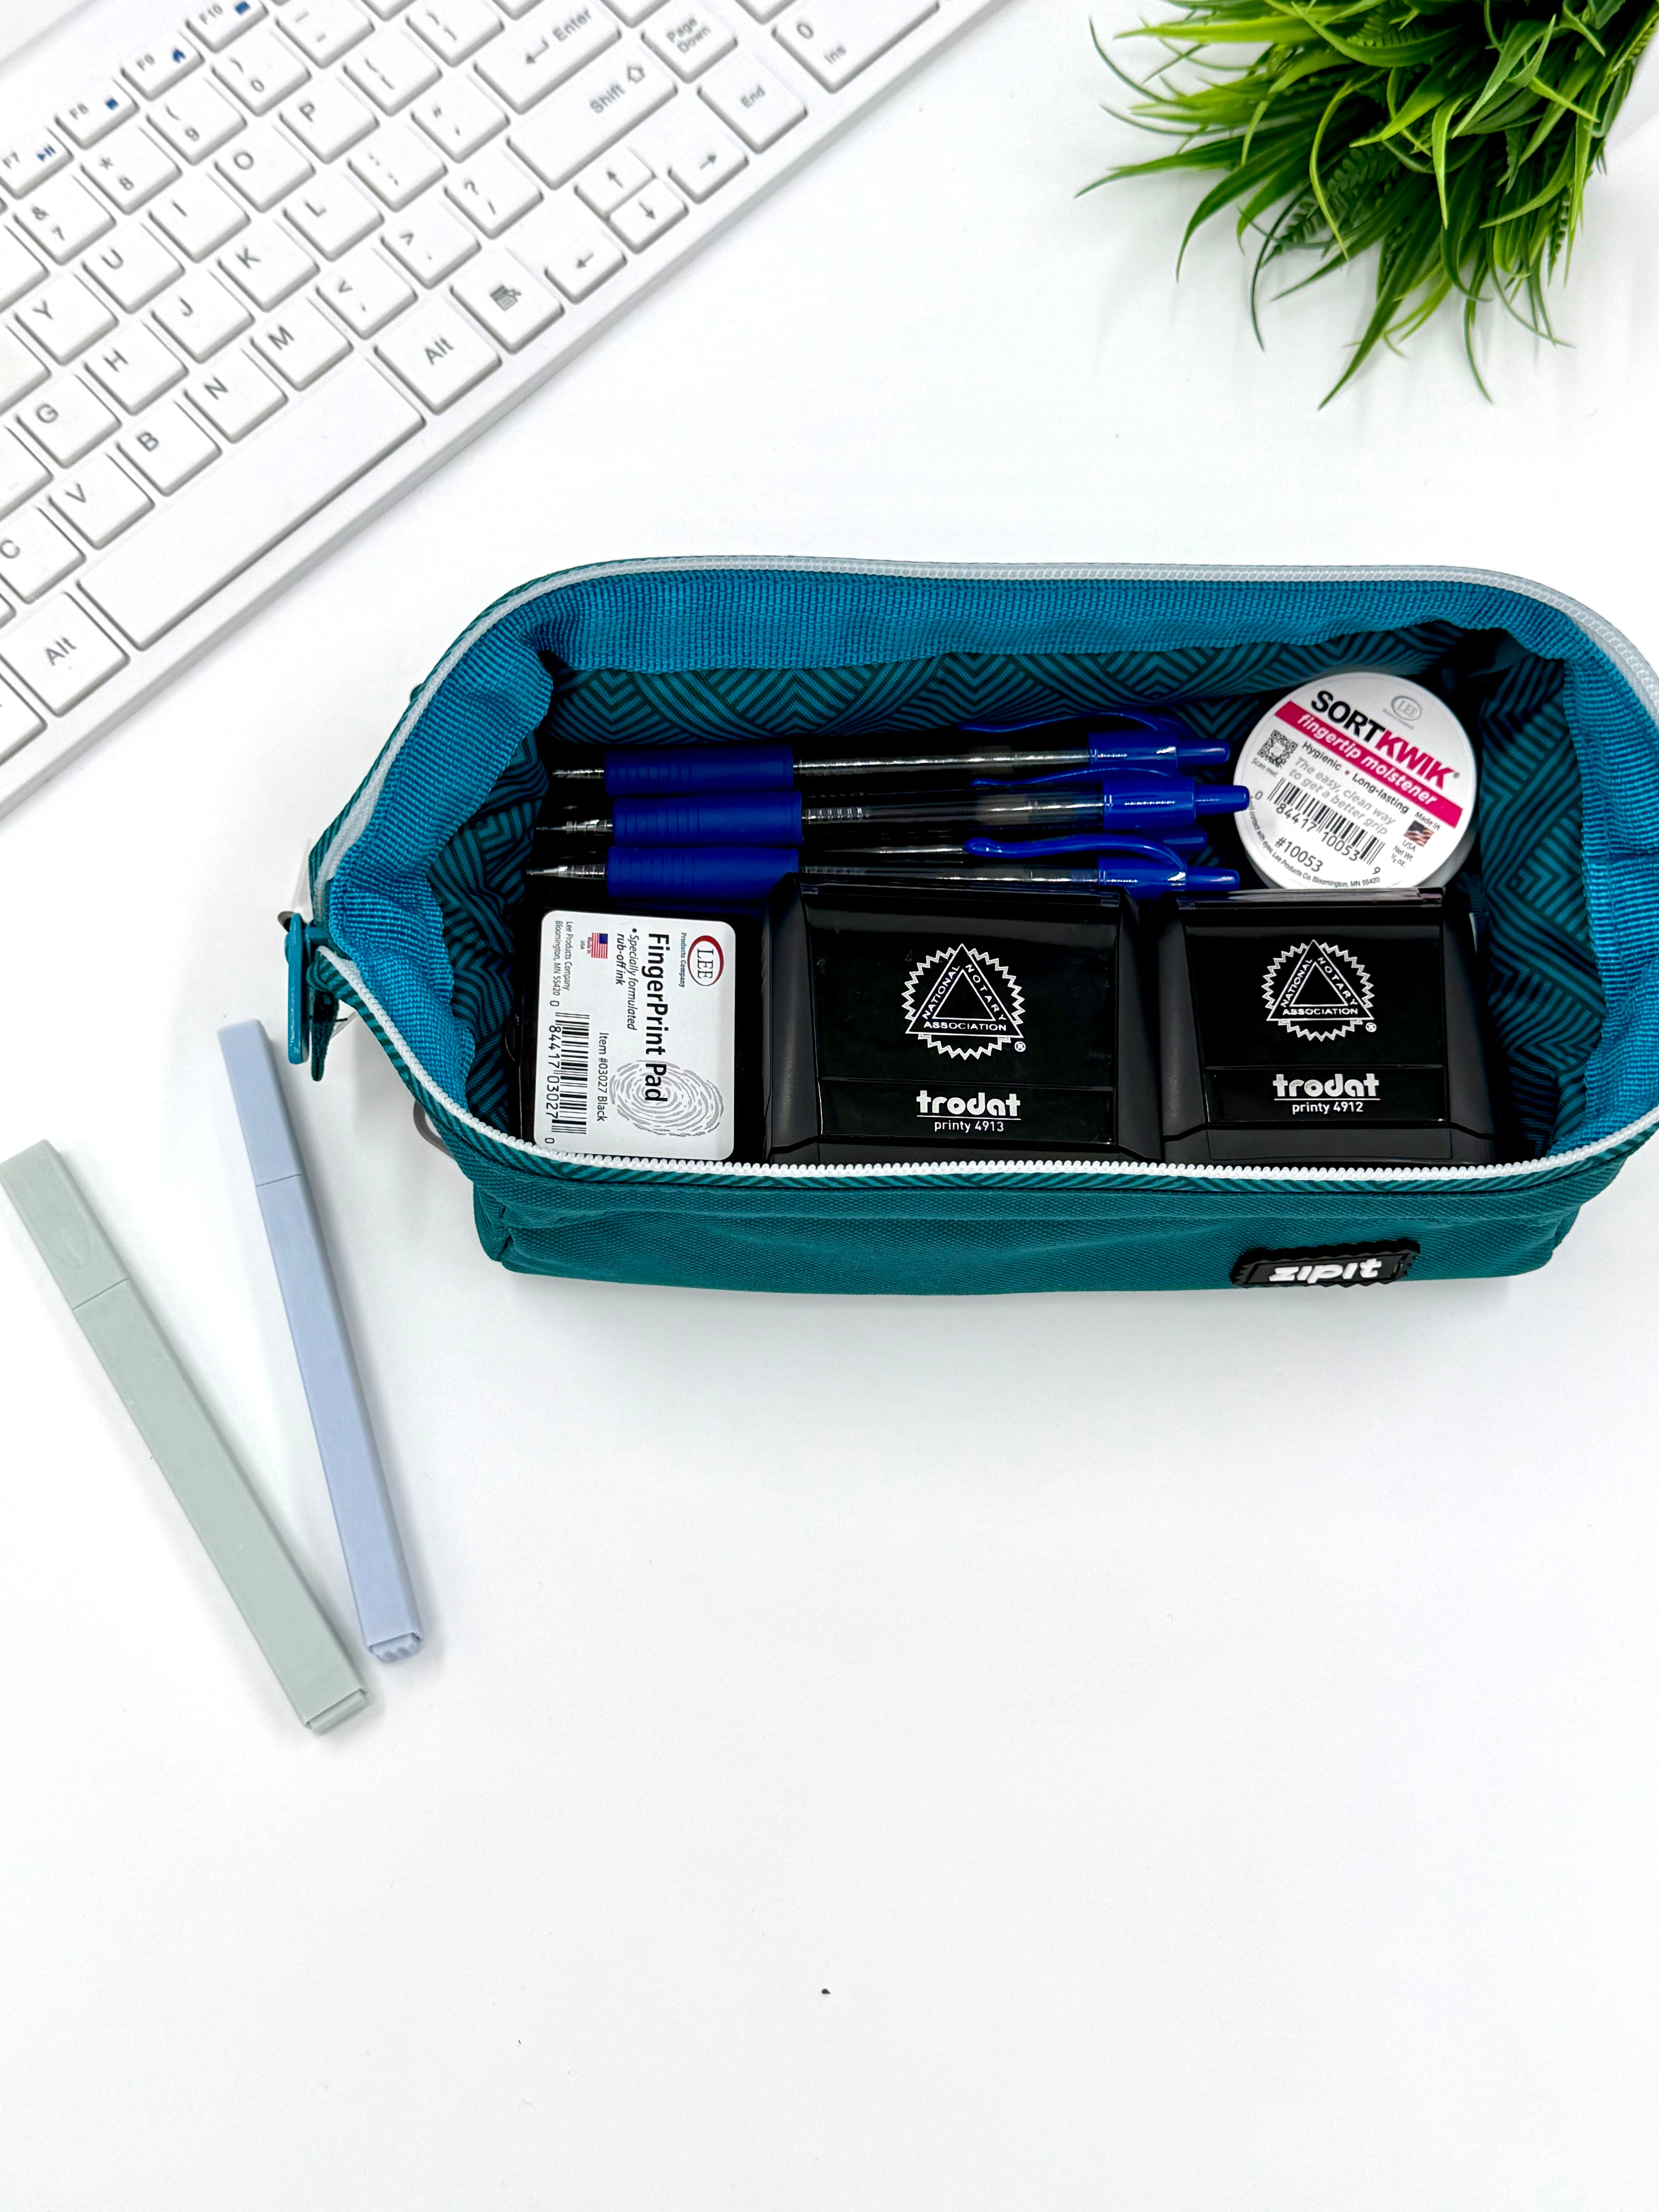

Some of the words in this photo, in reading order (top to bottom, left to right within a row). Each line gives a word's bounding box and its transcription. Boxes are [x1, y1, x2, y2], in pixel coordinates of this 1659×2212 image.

[198, 3, 223, 25] F10
[552, 7, 592, 42] Enter
[666, 17, 698, 43] Page
[677, 25, 711, 55] Down
[796, 21, 814, 40] 0
[136, 54, 155, 71] F9
[824, 44, 847, 65] Ins
[249, 78, 265, 93] 0
[740, 86, 766, 108] End
[589, 83, 625, 114] Shift
[298, 101, 315, 122] P
[2, 151, 20, 169] F7
[233, 151, 254, 170] O
[304, 201, 327, 218] L
[101, 248, 124, 270] U
[236, 247, 261, 269] K
[33, 300, 53, 320] Y
[179, 297, 194, 317] J
[268, 326, 295, 350] M
[103, 349, 128, 372] H
[424, 337, 454, 366] Alt
[203, 376, 228, 400] N
[35, 403, 59, 424] G
[136, 431, 159, 452] B
[65, 483, 87, 503] V
[0, 539, 21, 559] C
[45, 637, 77, 666] Alt
[1297, 714, 1362, 759] fingertip
[1360, 756, 1438, 805] moistener
[1302, 741, 1342, 771] Hygienic
[1352, 773, 1410, 814] Long-lasting
[1290, 769, 1301, 780] to
[1300, 778, 1323, 793] get
[1330, 794, 1365, 819] better
[1363, 818, 1388, 834] grip
[1295, 757, 1315, 775] The
[1316, 773, 1341, 793] easy,
[1343, 789, 1372, 811] clean
[1373, 808, 1396, 825] way
[1255, 791, 1263, 800] 0
[1276, 804, 1317, 832] 84417
[1322, 832, 1360, 861] 10053
[1414, 811, 1432, 826] Made
[1275, 837, 1323, 872] #10053
[1403, 840, 1416, 852] USA
[1281, 860, 1302, 876] Products
[553, 921, 563, 960] Bloomington,
[565, 934, 574, 960] Products
[616, 933, 627, 969] rub-off
[627, 934, 639, 976] Specially
[697, 948, 714, 979] LEE
[554, 963, 561, 974] MN
[563, 962, 573, 991] Company
[616, 969, 626, 985] ink
[678, 960, 687, 988] Company
[553, 976, 561, 996] 55420
[922, 965, 960, 1018] NATIONAL
[965, 964, 1006, 1021] NOTARY
[1281, 959, 1312, 1008] NATIONAL
[1317, 957, 1358, 1005] NOTARY
[627, 977, 639, 1030] formulated
[641, 933, 670, 1054] FingerPrint
[1283, 1008, 1358, 1016] ASSOCIATION
[924, 1021, 1006, 1032] ASSOCIATION
[548, 1025, 561, 1069] 84417
[599, 1032, 609, 1054] Item
[598, 1058, 608, 1093] #03027
[644, 1063, 667, 1102] Pad
[1273, 1073, 1379, 1097] trodat
[546, 1076, 560, 1118] 03027
[597, 1096, 608, 1121] Black
[916, 1090, 1020, 1116] trodat
[1292, 1102, 1329, 1114] printy
[1333, 1102, 1363, 1112] 4912
[934, 1120, 970, 1132] printy
[975, 1121, 1004, 1132] 4913
